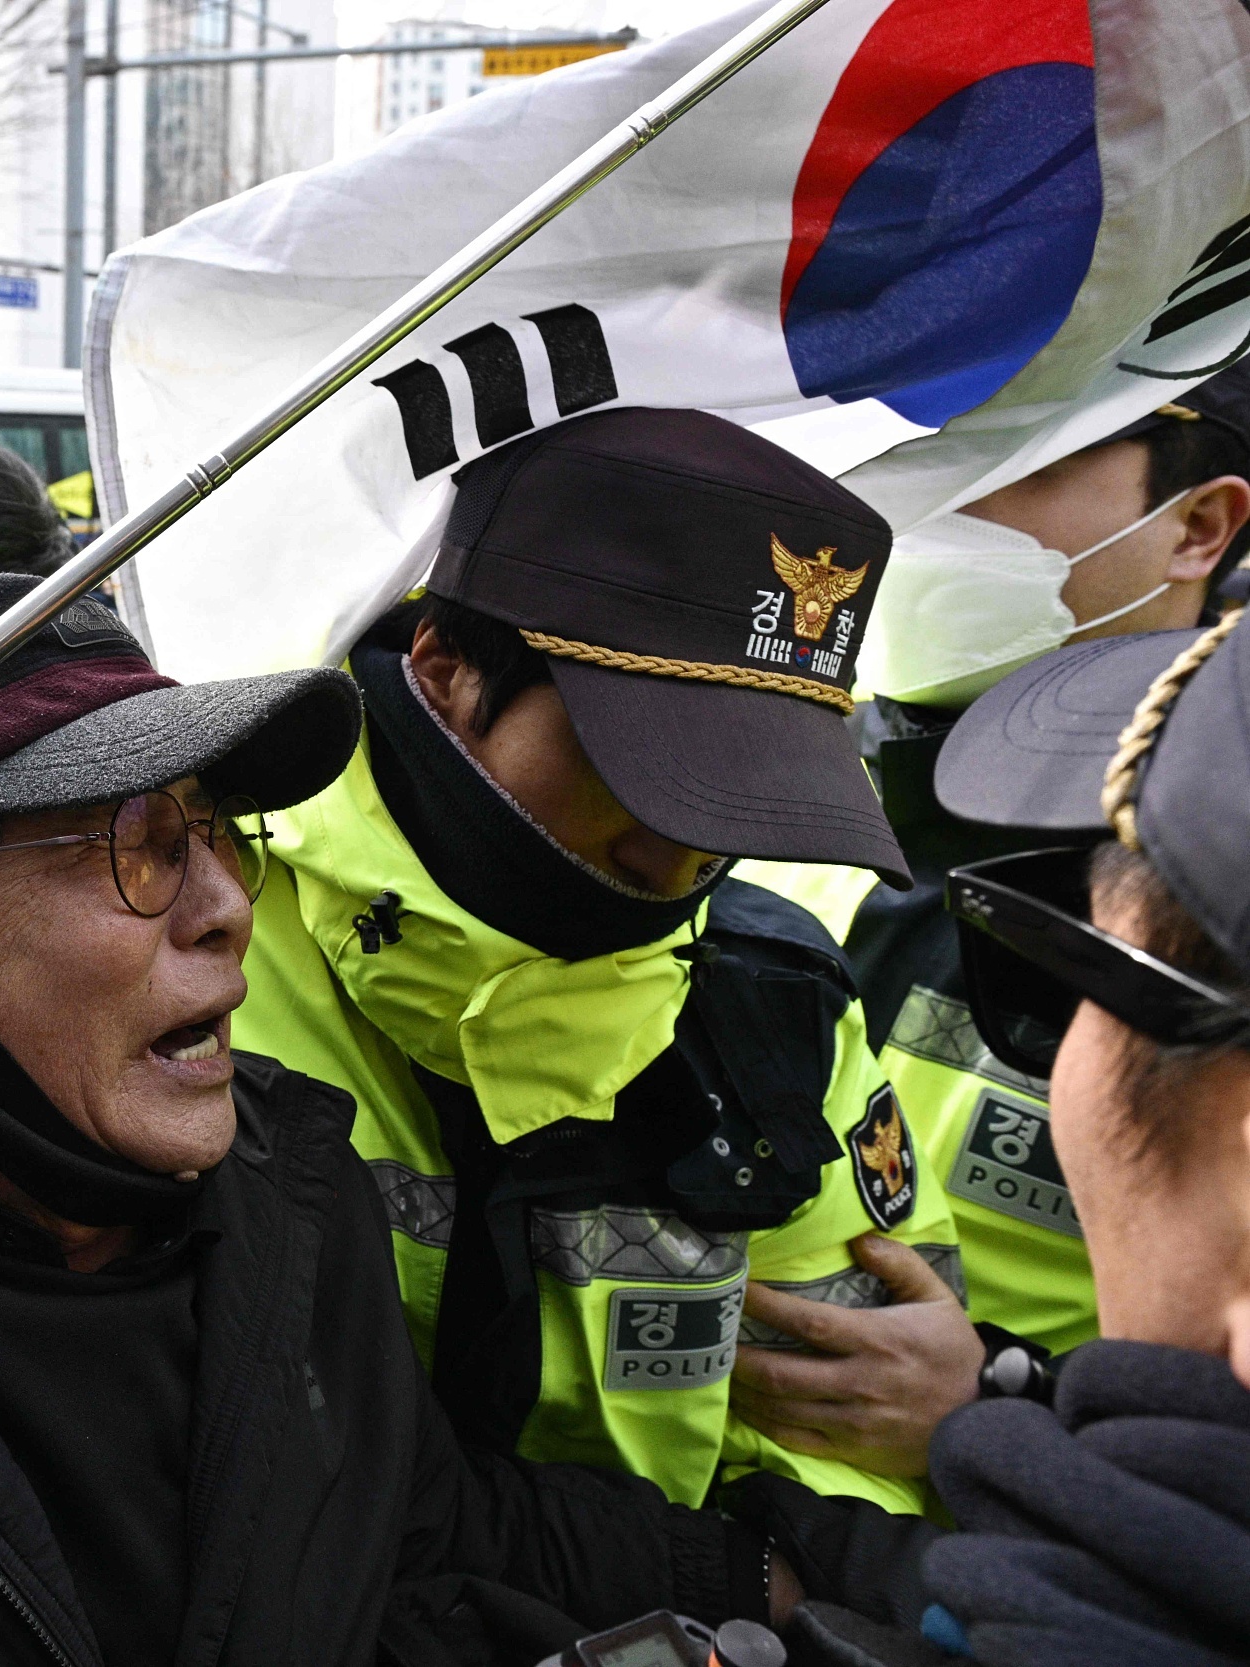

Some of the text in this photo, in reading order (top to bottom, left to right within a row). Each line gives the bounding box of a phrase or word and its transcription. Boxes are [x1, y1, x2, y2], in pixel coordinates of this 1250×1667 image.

[751, 589, 856, 655] 경 찰
[987, 1105, 1042, 1167] 경
[965, 1165, 1081, 1223] POLI
[629, 1303, 679, 1350] 경
